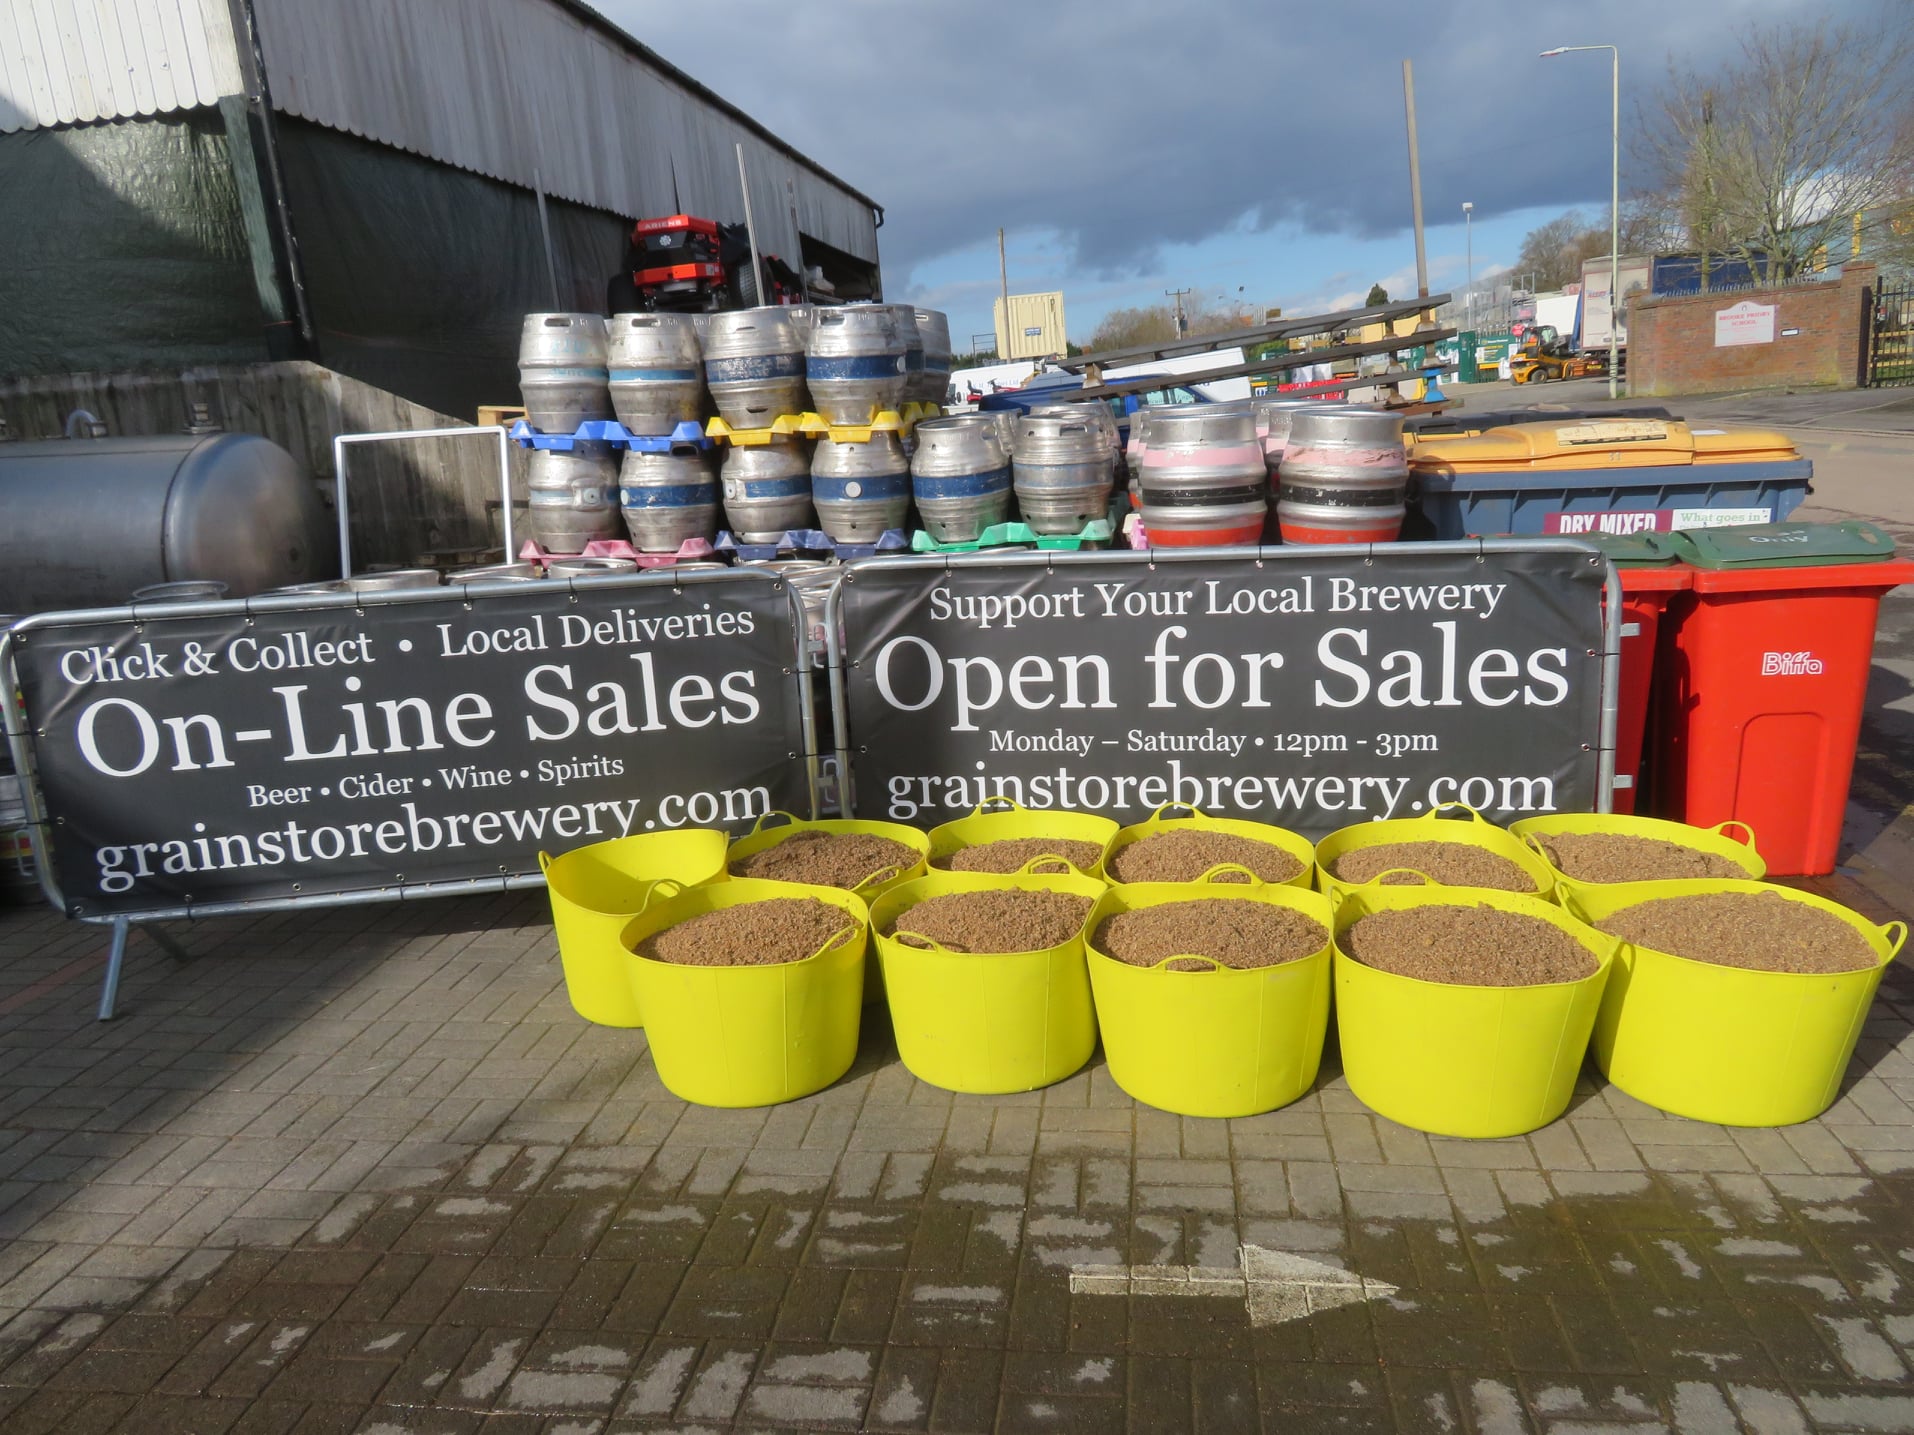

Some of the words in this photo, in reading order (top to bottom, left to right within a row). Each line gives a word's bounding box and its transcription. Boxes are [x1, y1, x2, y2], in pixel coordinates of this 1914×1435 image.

[1560, 514, 1595, 533] DRY
[1600, 513, 1656, 535] MIXED
[1680, 512, 1713, 522] What
[1716, 511, 1745, 524] goes
[1748, 511, 1761, 522] in
[930, 586, 1085, 630] Support
[1093, 582, 1194, 617] Your
[1204, 576, 1316, 615] Local
[1327, 576, 1508, 620] Brewery
[60, 641, 173, 685] Click
[183, 641, 220, 677] &
[228, 631, 376, 673] Collect
[436, 614, 549, 657] Local
[557, 603, 756, 648] Deliveries
[1761, 651, 1823, 676] Biffa
[874, 635, 1118, 732] Open
[1144, 625, 1285, 708] for
[1313, 620, 1570, 708] Sales
[76, 676, 497, 778] On-Line
[523, 651, 761, 741] Sales
[988, 727, 1094, 758] Monday
[1126, 727, 1248, 758] Saturday
[1273, 733, 1349, 758] 12pm
[1375, 733, 1439, 758] 3pm
[246, 784, 312, 808] Beer
[337, 772, 414, 800] Cider
[437, 766, 514, 791] Wine
[537, 755, 626, 787] Spirits
[887, 760, 1558, 823] grainstorebrewery.com
[96, 785, 772, 894] grainstorebrewery.com
